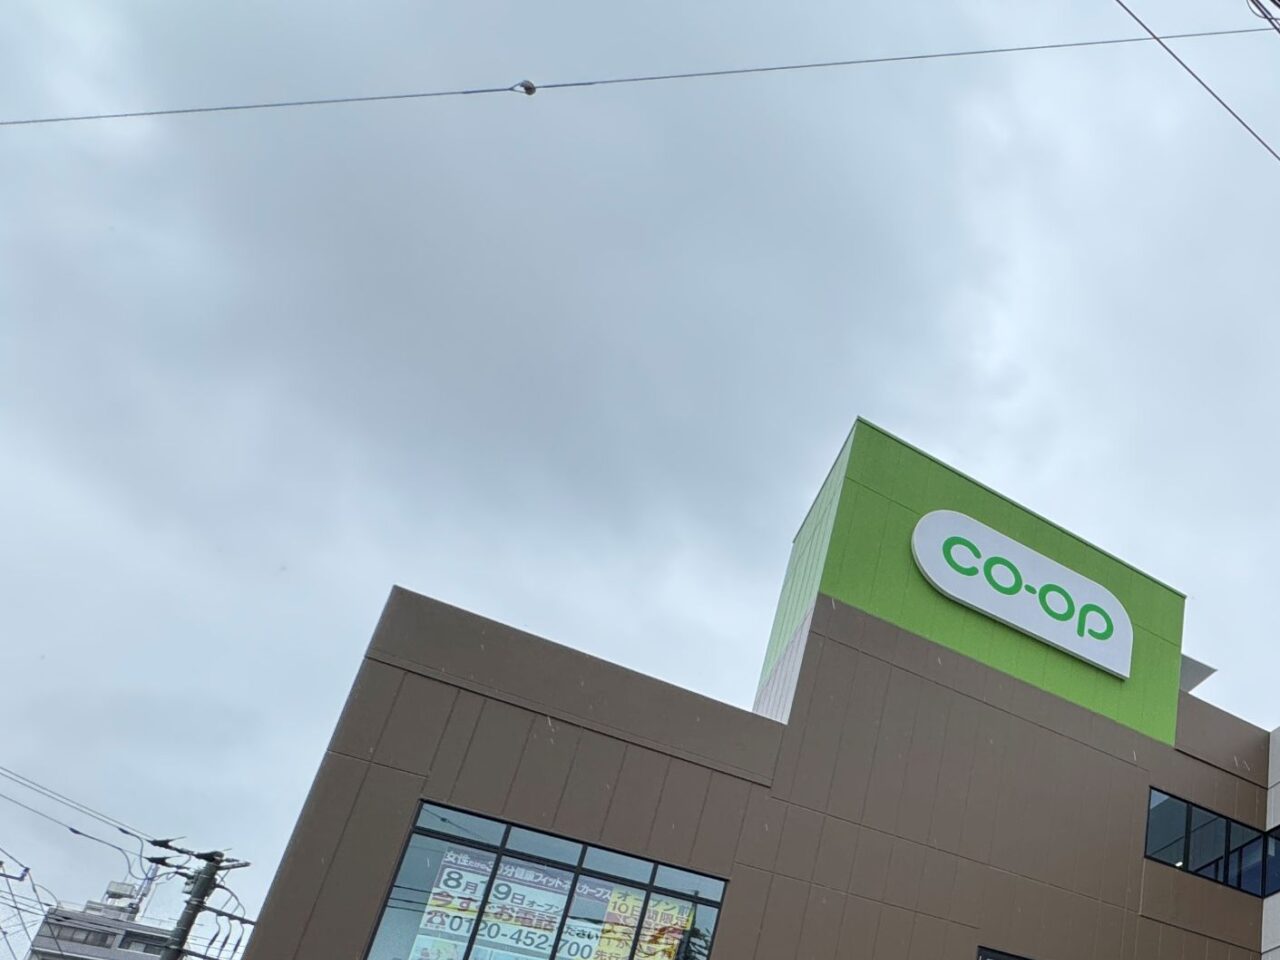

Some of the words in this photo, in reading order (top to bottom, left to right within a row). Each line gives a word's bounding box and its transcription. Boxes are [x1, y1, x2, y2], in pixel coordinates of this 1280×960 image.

[443, 871, 564, 913] 8月9日オープン
